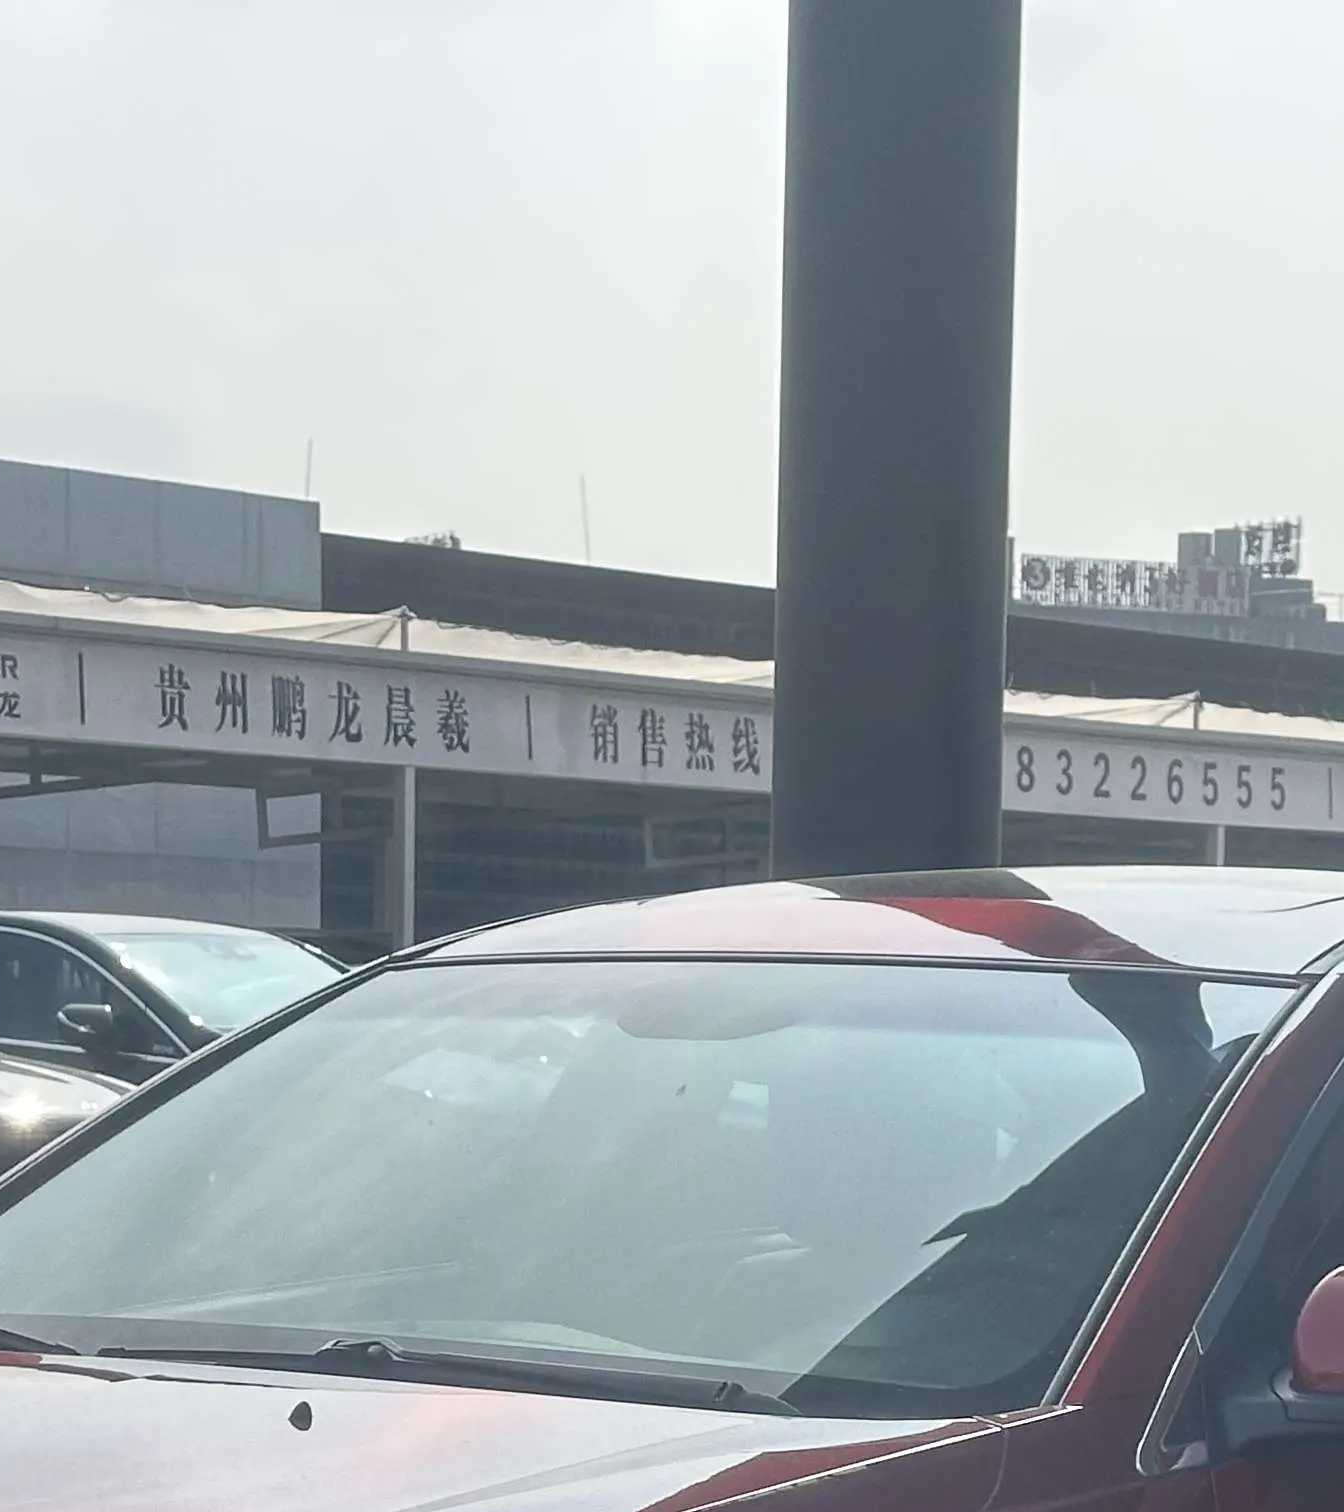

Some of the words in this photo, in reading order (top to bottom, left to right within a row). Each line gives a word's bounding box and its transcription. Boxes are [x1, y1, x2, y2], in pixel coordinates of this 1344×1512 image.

[154, 663, 471, 754] 贵州鹏龙晨羲
[588, 703, 761, 776] 销售热线
[1016, 746, 1287, 811] 83226555
